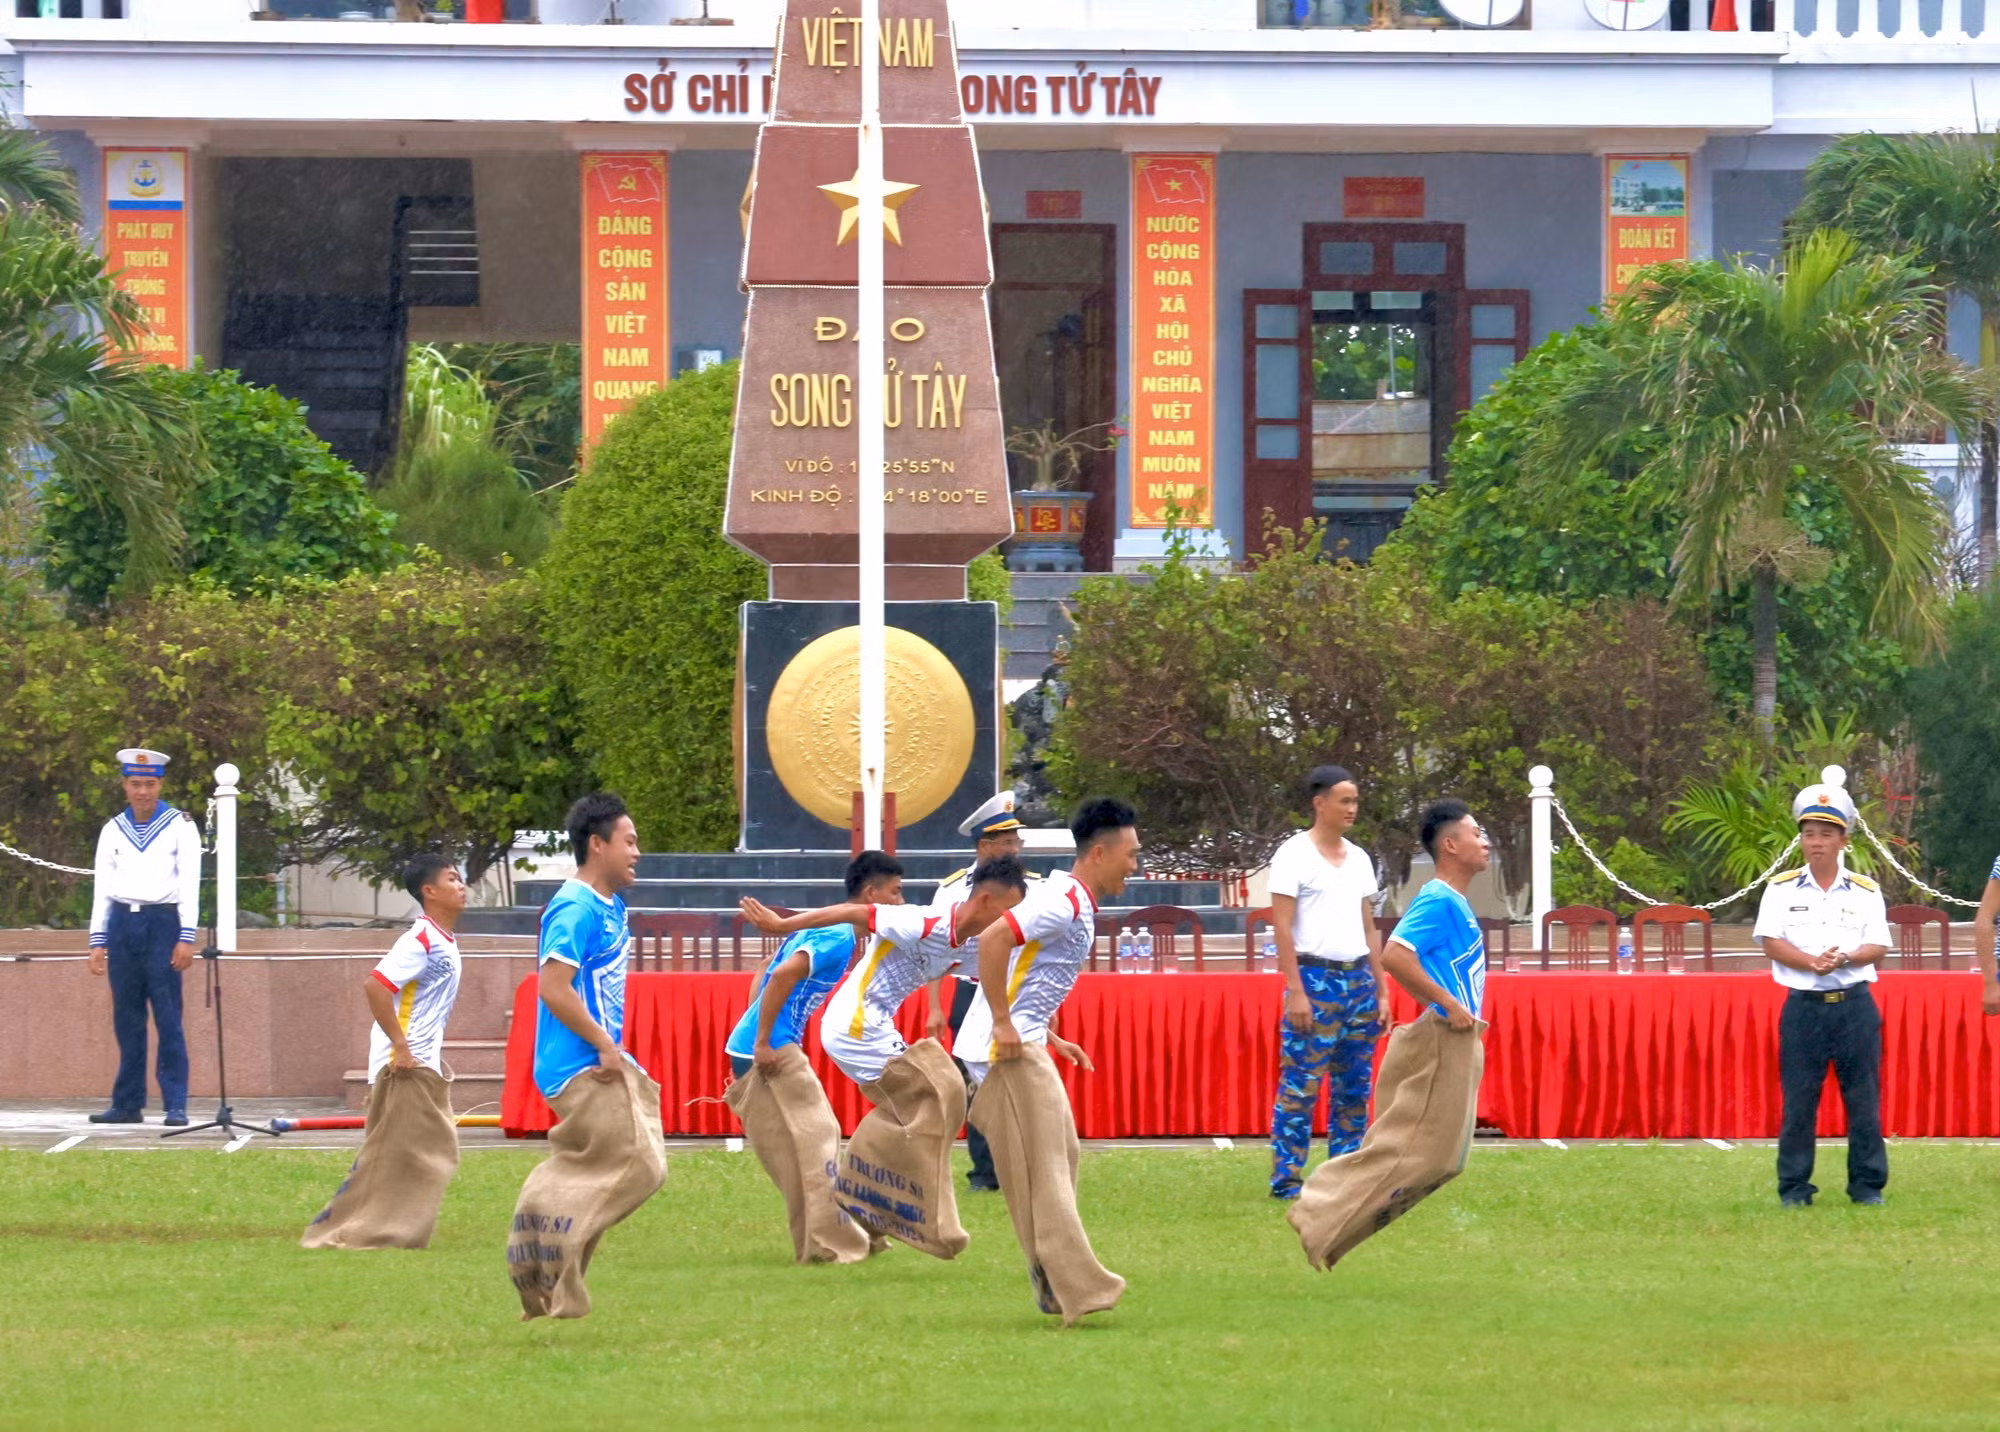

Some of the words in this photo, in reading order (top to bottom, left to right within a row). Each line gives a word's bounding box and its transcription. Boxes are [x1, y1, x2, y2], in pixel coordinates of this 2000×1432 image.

[802, 7, 863, 74] VIỆT
[878, 18, 933, 67] NAM
[624, 57, 676, 113] SỞ
[688, 57, 749, 113] CHỈ
[960, 75, 1037, 114] ONG
[1046, 60, 1097, 115] TỬ
[1100, 67, 1162, 115] TÂY
[117, 219, 148, 239] PHÁT
[151, 222, 174, 239] HUY
[598, 210, 652, 235] ĐẢNG
[1146, 214, 1200, 233] NƯỚC
[599, 245, 652, 272] CỘNG
[1146, 240, 1200, 262] CỘNG
[1153, 266, 1193, 286] HÒA
[605, 275, 646, 301] SẢN
[1160, 294, 1187, 312] XÃ
[605, 311, 647, 338] VIỆT
[814, 316, 925, 341] ĐO
[1156, 320, 1189, 343] HỘI
[603, 348, 649, 367] NAM
[1152, 345, 1193, 366] CHỦ
[1142, 374, 1203, 393] NGHĨA
[770, 373, 851, 428] SONG
[911, 361, 967, 429] TÂY
[1152, 400, 1193, 423] VIỆT
[1148, 430, 1195, 446] NAM
[807, 456, 834, 477] ĐỘ
[1142, 453, 1201, 473] MUÔN
[751, 489, 803, 502] KINH
[809, 484, 842, 507] ĐỘ
[1148, 480, 1193, 499] NĂM
